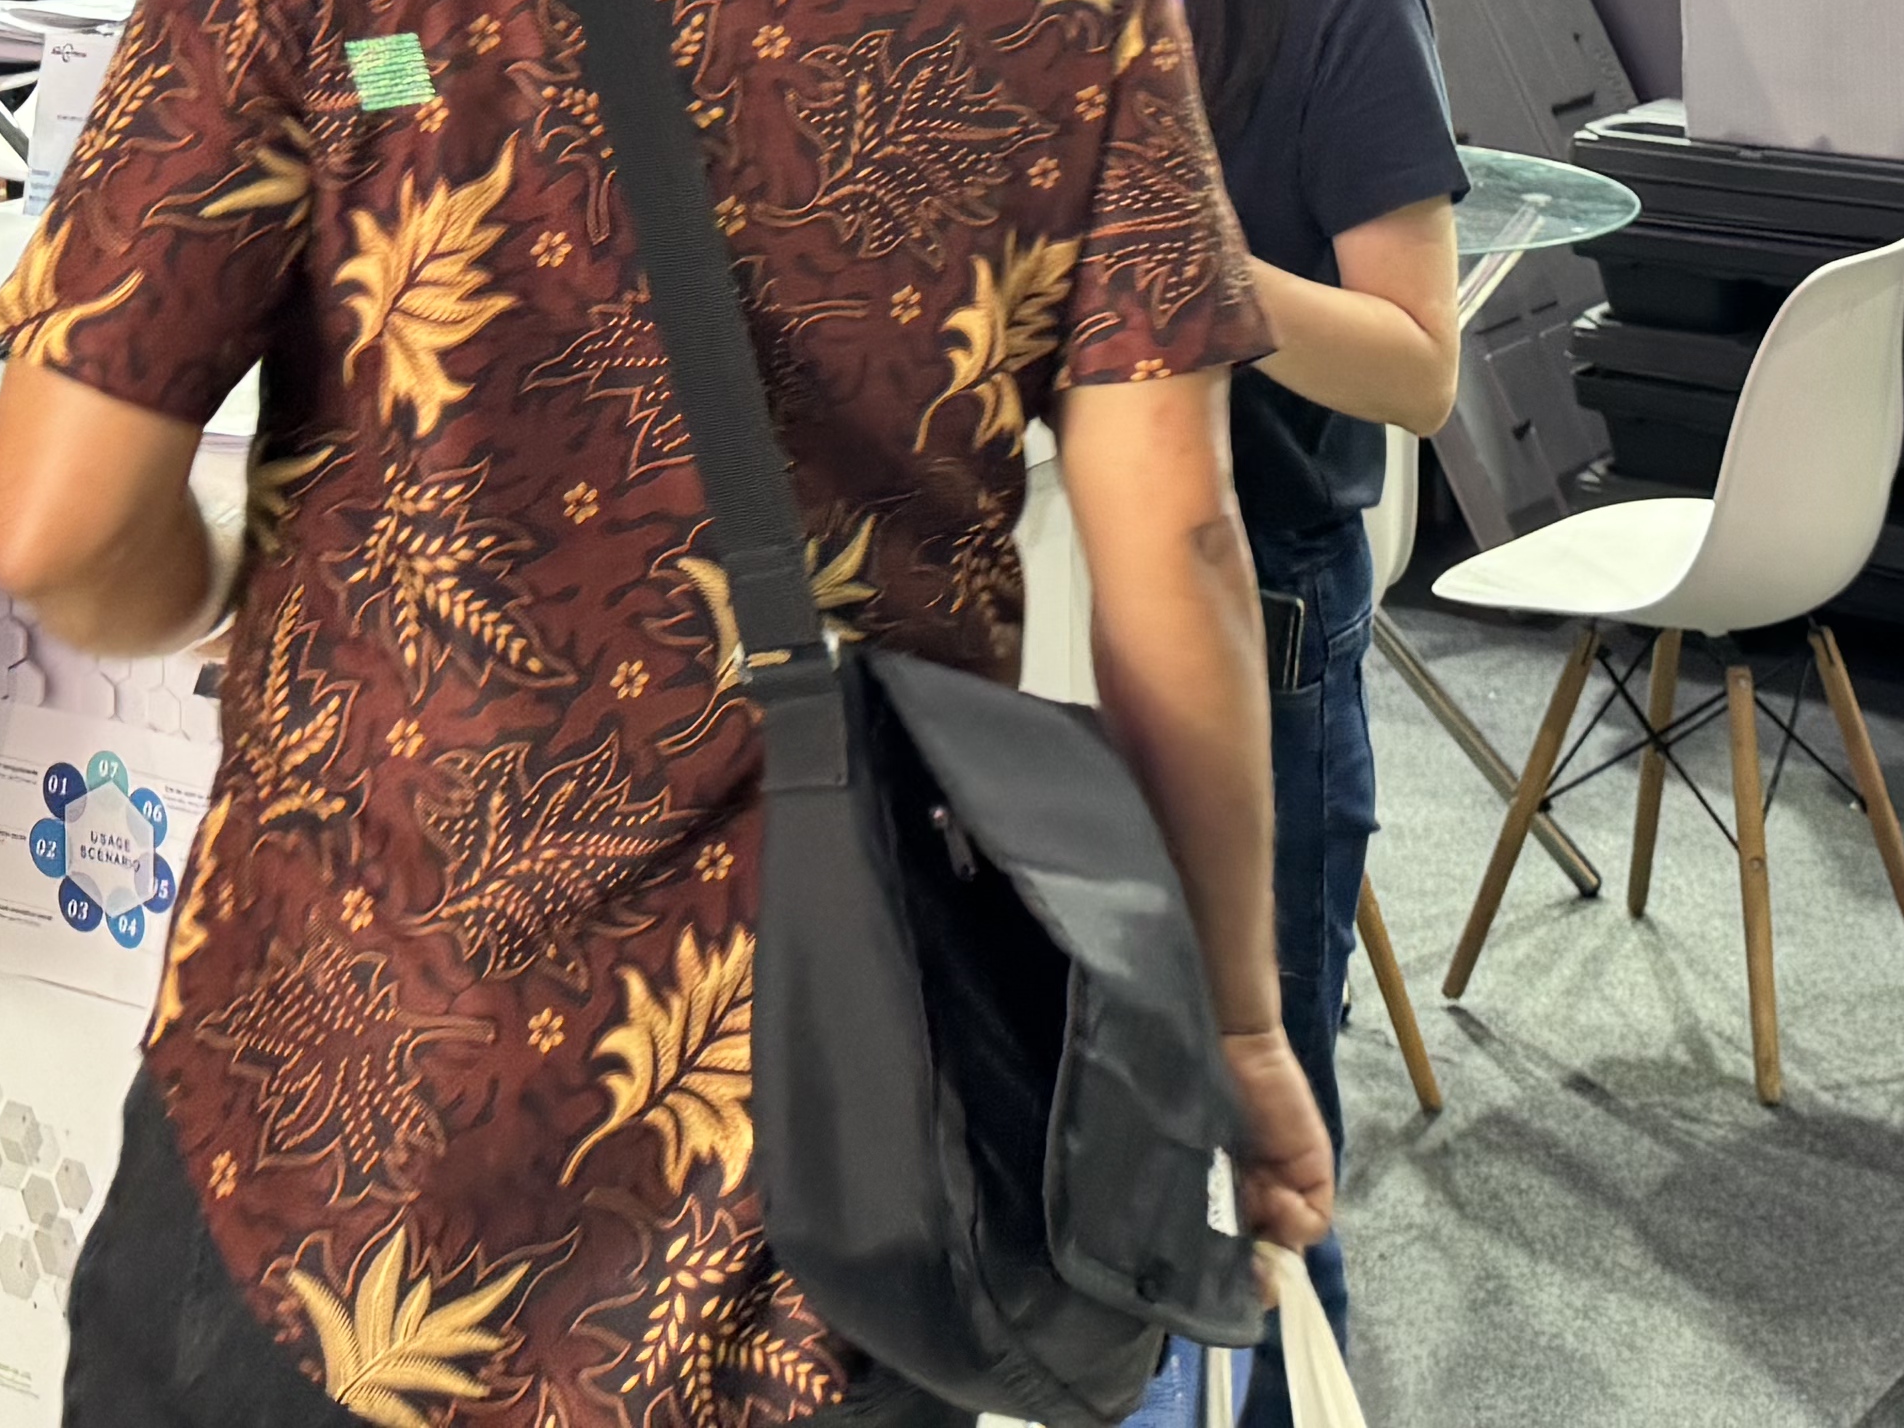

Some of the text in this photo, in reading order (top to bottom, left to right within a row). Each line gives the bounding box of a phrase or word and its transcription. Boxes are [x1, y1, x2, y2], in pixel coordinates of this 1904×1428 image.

[98, 758, 119, 779] 07
[48, 774, 68, 794] 01
[143, 800, 163, 823] 06
[36, 838, 57, 860] 02
[90, 830, 131, 853] USAGE
[80, 844, 141, 873] SCENARIO
[67, 898, 90, 921] 03
[118, 915, 137, 937] 04
